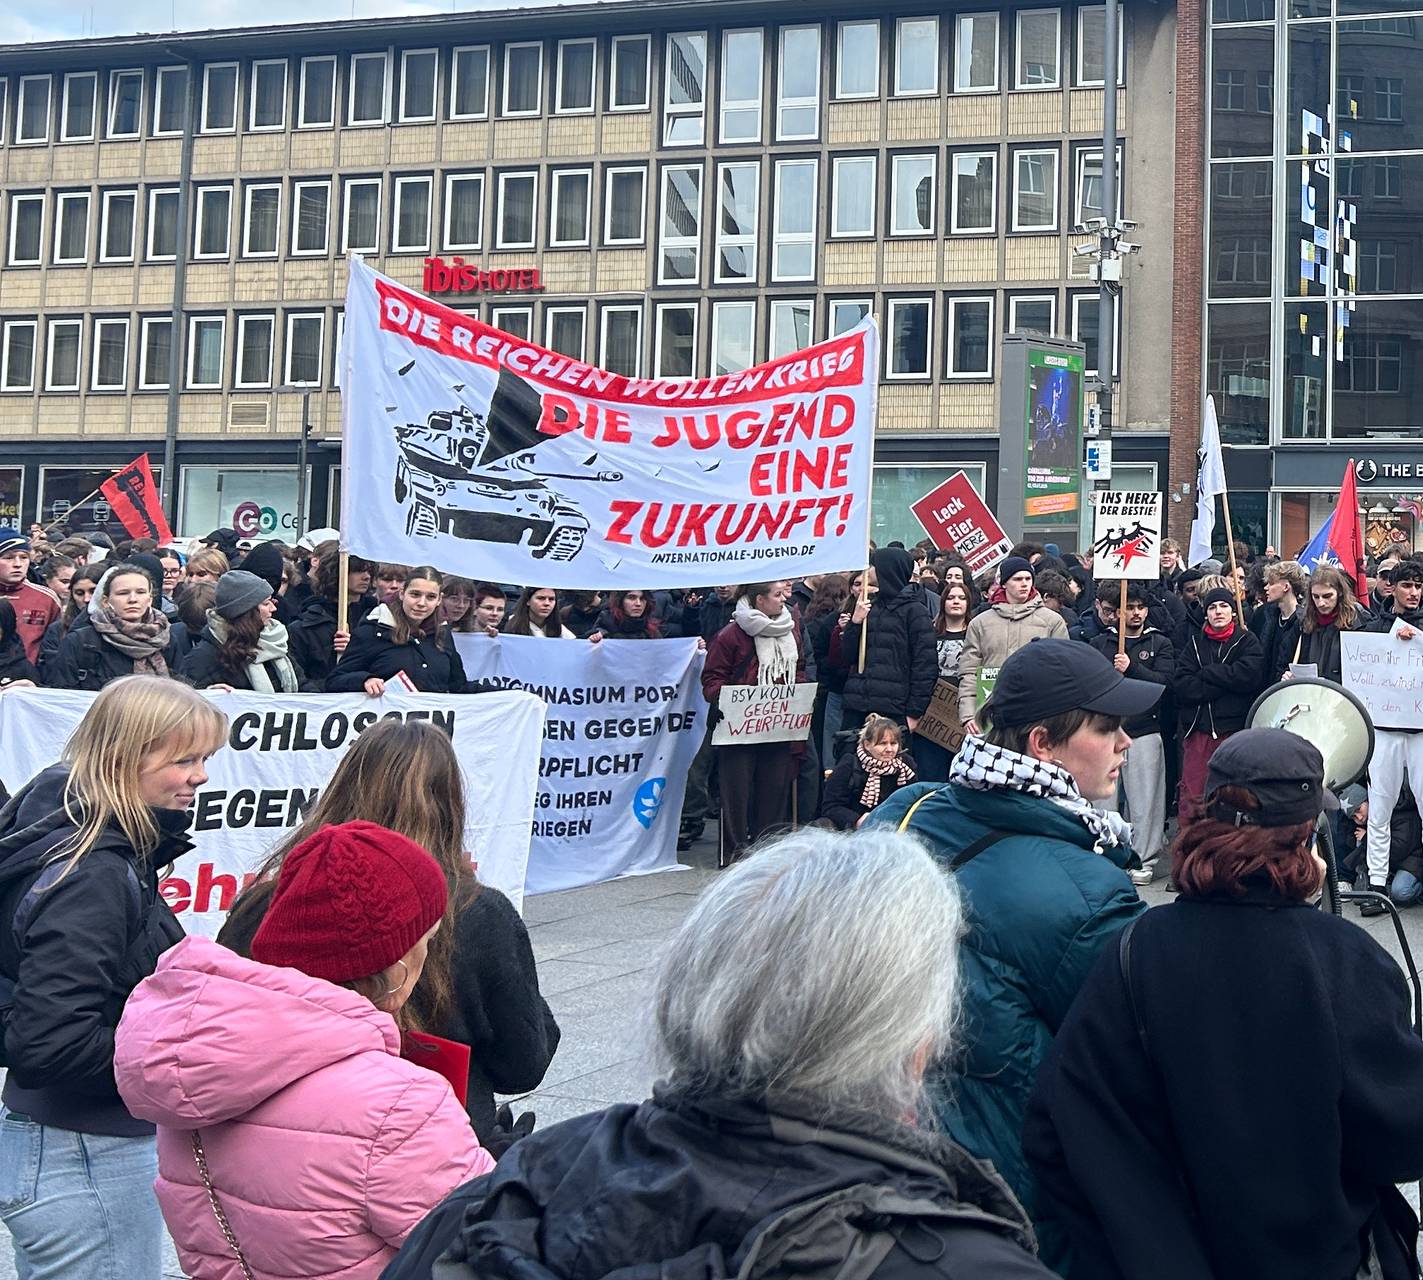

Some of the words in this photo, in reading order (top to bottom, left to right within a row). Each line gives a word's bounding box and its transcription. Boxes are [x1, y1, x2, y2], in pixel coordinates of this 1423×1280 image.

[423, 257, 477, 293] ibis
[478, 269, 546, 291] HOTEL
[384, 298, 440, 340] DIE
[451, 325, 615, 392] REICHEN
[622, 373, 757, 402] WOLLEN
[764, 346, 855, 390] KRIEG
[538, 393, 633, 444] DIE
[651, 393, 857, 449] JUGEND
[750, 443, 854, 496] EINE
[1382, 463, 1411, 477] THE
[1101, 492, 1122, 504] INS
[1125, 492, 1158, 505] HERZ
[604, 494, 852, 548] ZUKUNFT!
[932, 496, 965, 524] Leck
[1100, 505, 1119, 515] DER
[1121, 505, 1157, 516] BESTIE!
[946, 517, 974, 542] Eier
[651, 544, 815, 563] INTERNATIONALE-JUGEND.DE
[956, 531, 985, 554] MERZ
[1345, 642, 1379, 664] Wenn
[1387, 650, 1400, 664] ihr
[731, 688, 757, 703] BSV
[1381, 701, 1400, 712] den
[744, 700, 789, 718] GEGEN
[584, 716, 665, 740] GEGEN
[538, 753, 644, 778] RPFLICHT
[556, 790, 612, 809] IHREN
[531, 819, 592, 837] RIEGEN
